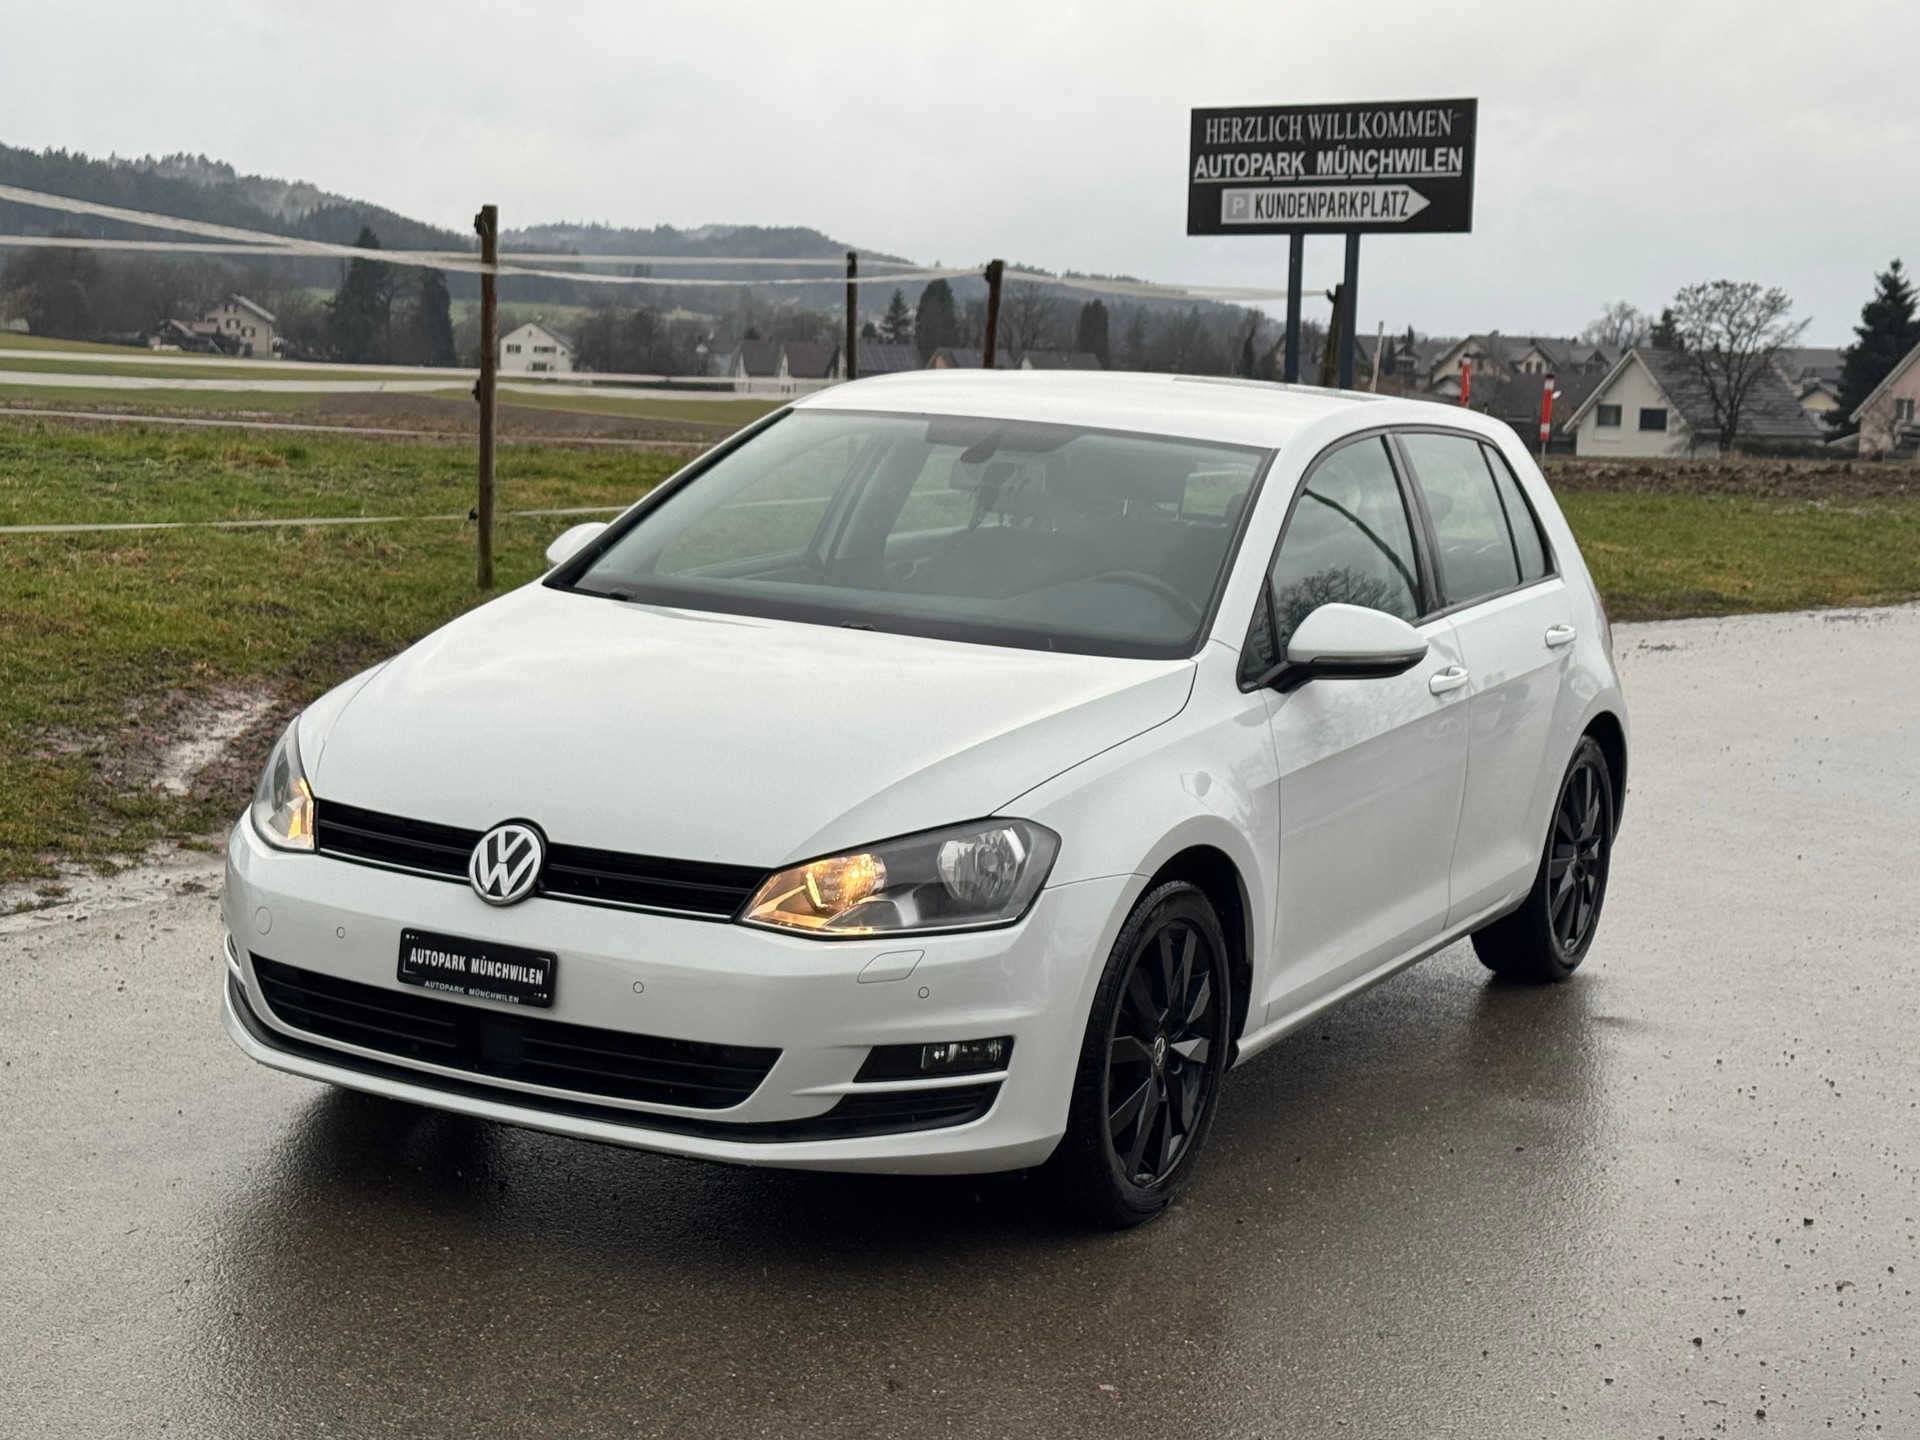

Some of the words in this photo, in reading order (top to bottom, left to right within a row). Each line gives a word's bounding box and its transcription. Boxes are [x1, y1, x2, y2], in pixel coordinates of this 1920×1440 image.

[1205, 114, 1303, 144] HERZLICH
[1308, 109, 1453, 141] WILLKOMMEN
[1194, 151, 1306, 178] AUTOPARK
[1316, 144, 1464, 174] MÜNCHWILEN
[1232, 197, 1245, 215] P
[1254, 190, 1410, 219] KUNDENPARKPLATZ
[472, 825, 541, 900] VW
[410, 947, 466, 972] AUTOPARK
[471, 955, 544, 985] MÜNCHWILEN
[424, 980, 465, 994] AUTOPARK
[468, 987, 519, 1004] MÜNCHWILEN
